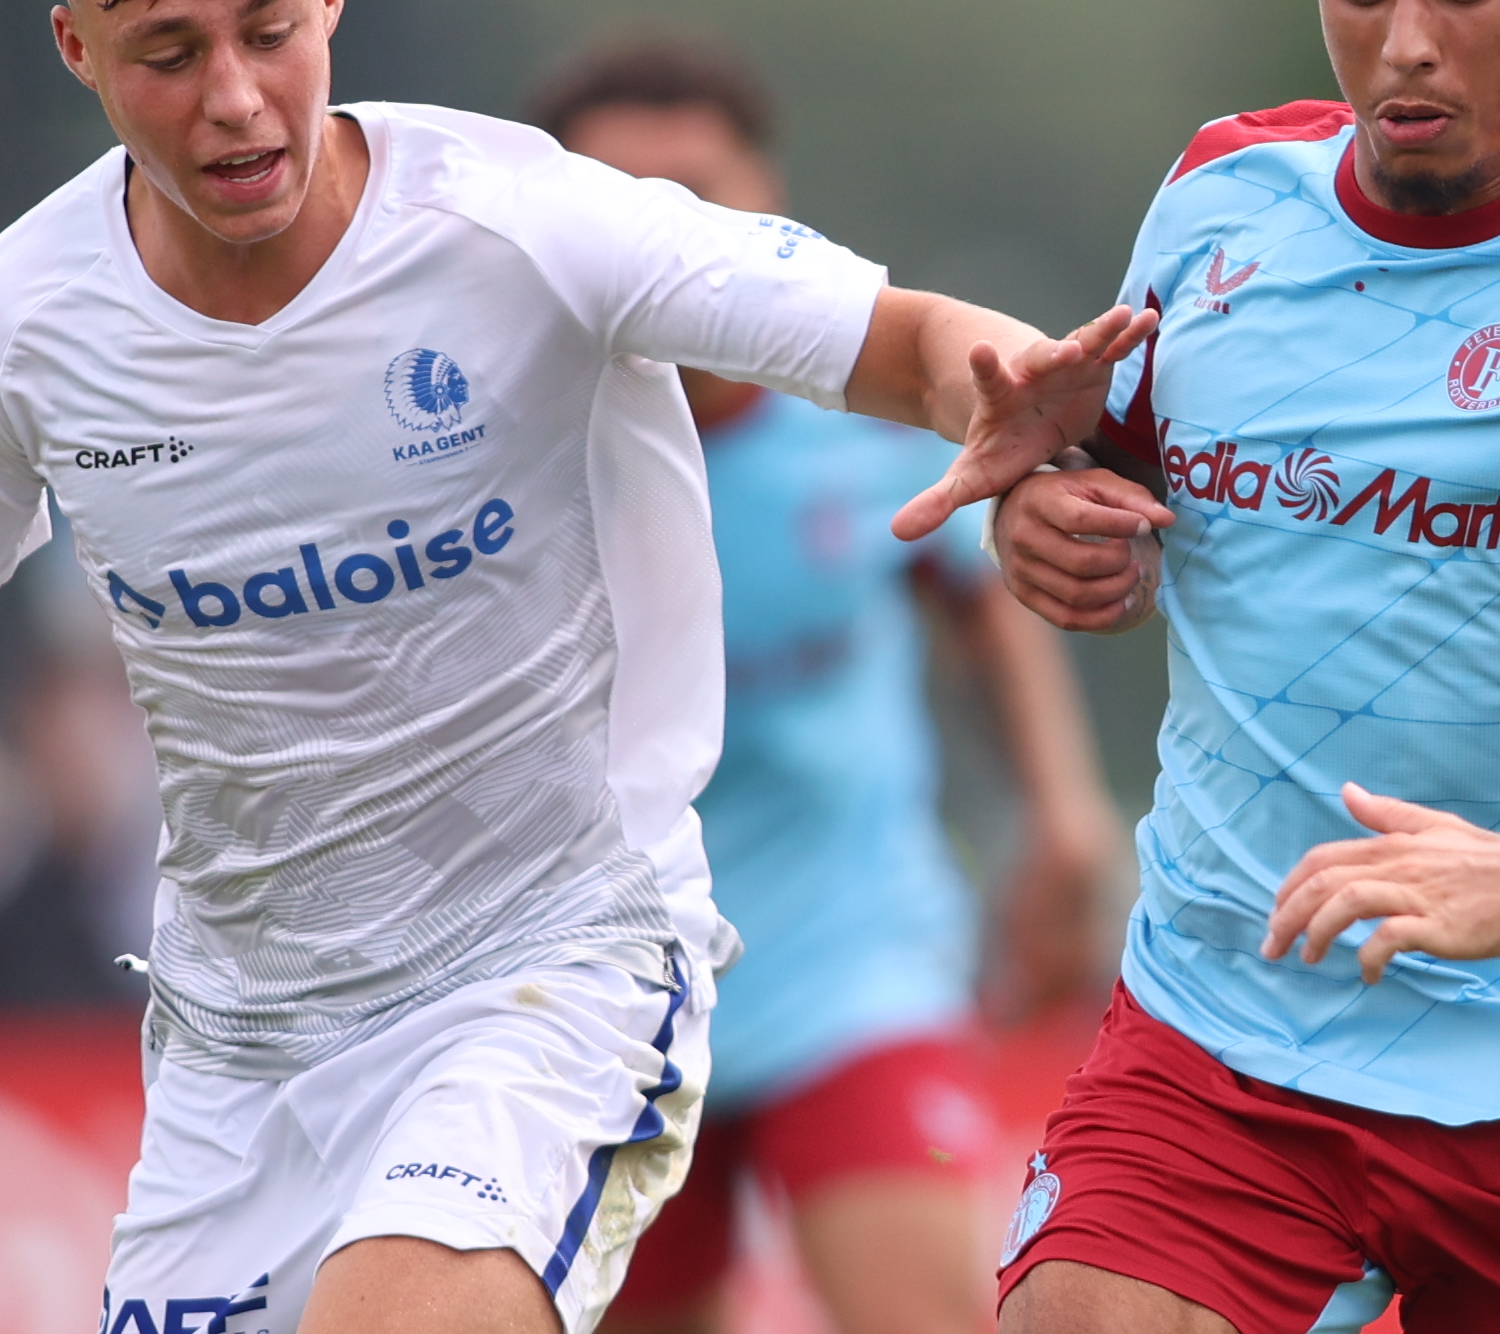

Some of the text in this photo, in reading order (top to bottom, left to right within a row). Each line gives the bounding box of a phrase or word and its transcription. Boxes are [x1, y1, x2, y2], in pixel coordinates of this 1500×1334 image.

[75, 443, 165, 469] CRAFT
[392, 443, 434, 461] KAA
[436, 424, 486, 451] GENT
[168, 497, 515, 628] baloise
[385, 1163, 483, 1187] CRAFT
